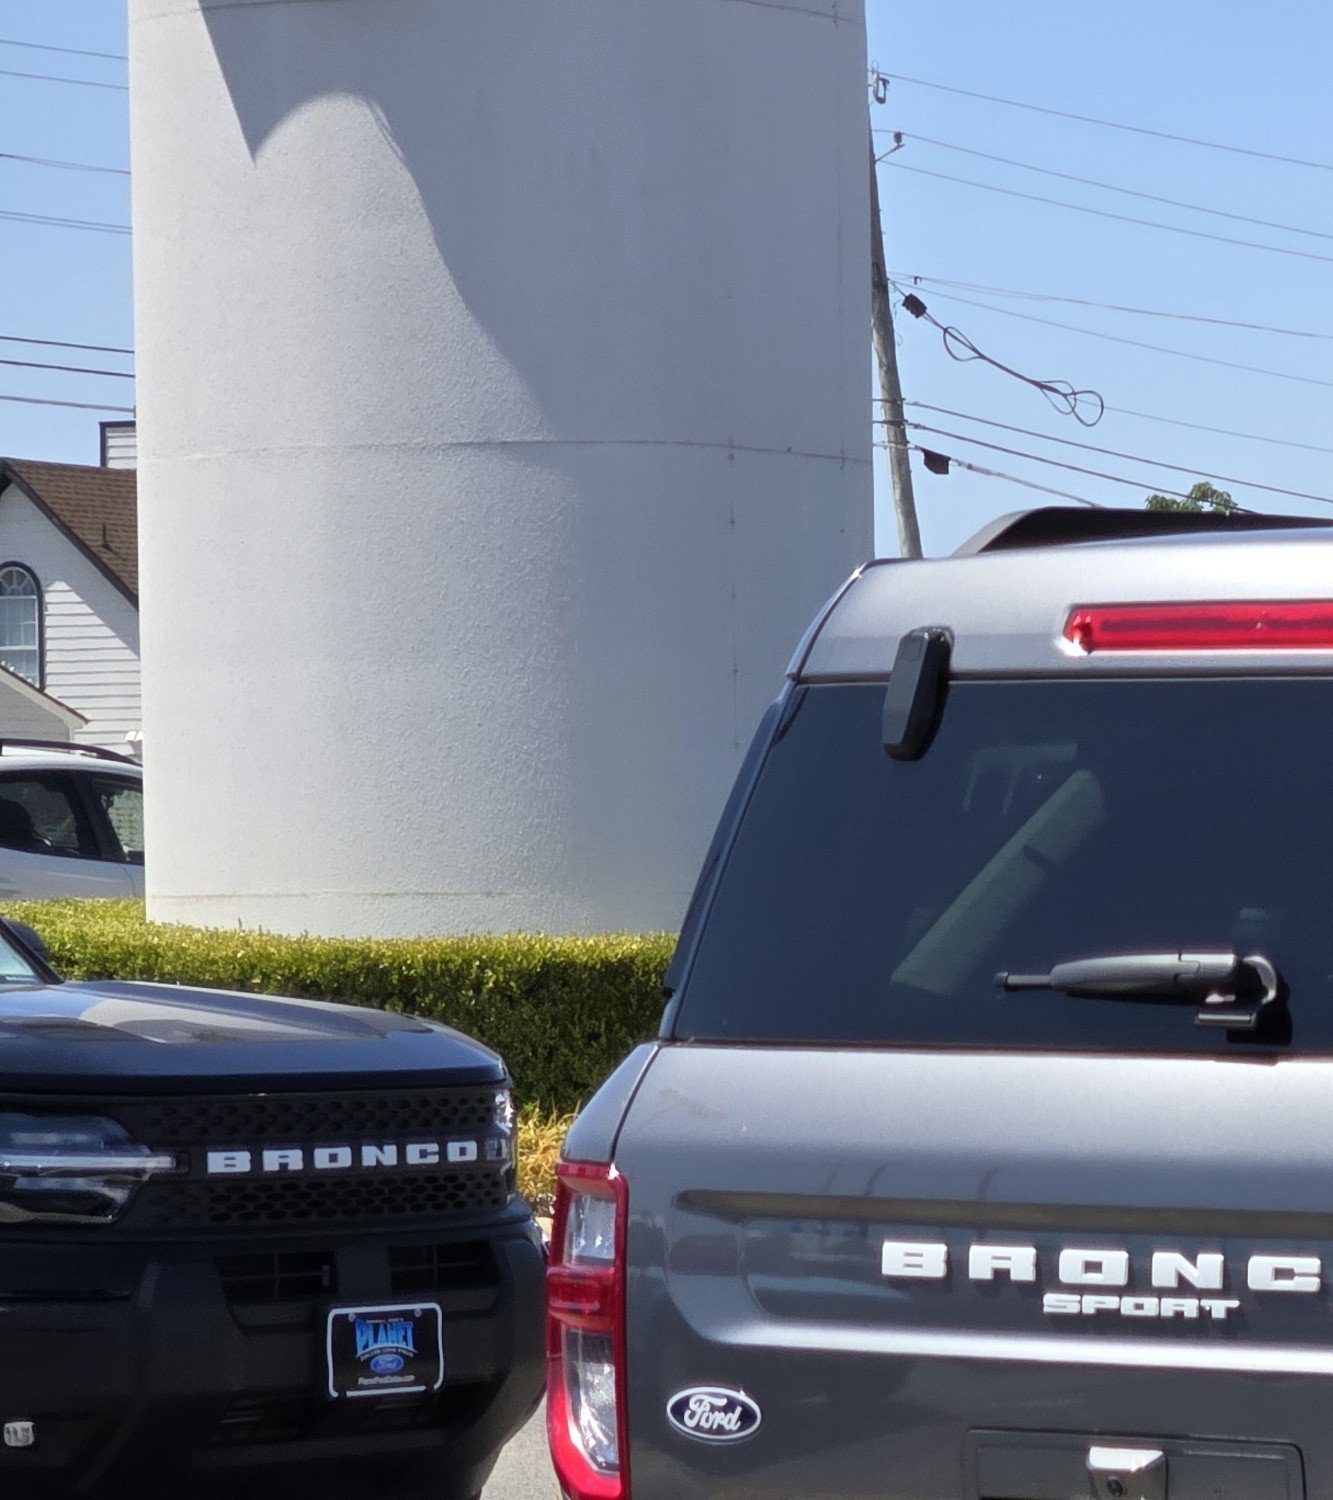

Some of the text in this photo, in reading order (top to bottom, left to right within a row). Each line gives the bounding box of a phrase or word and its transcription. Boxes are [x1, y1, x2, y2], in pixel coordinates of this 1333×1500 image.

[207, 1141, 478, 1173] BRONCO
[1043, 1293, 1240, 1318] SPORT
[355, 1318, 414, 1357] PLANET
